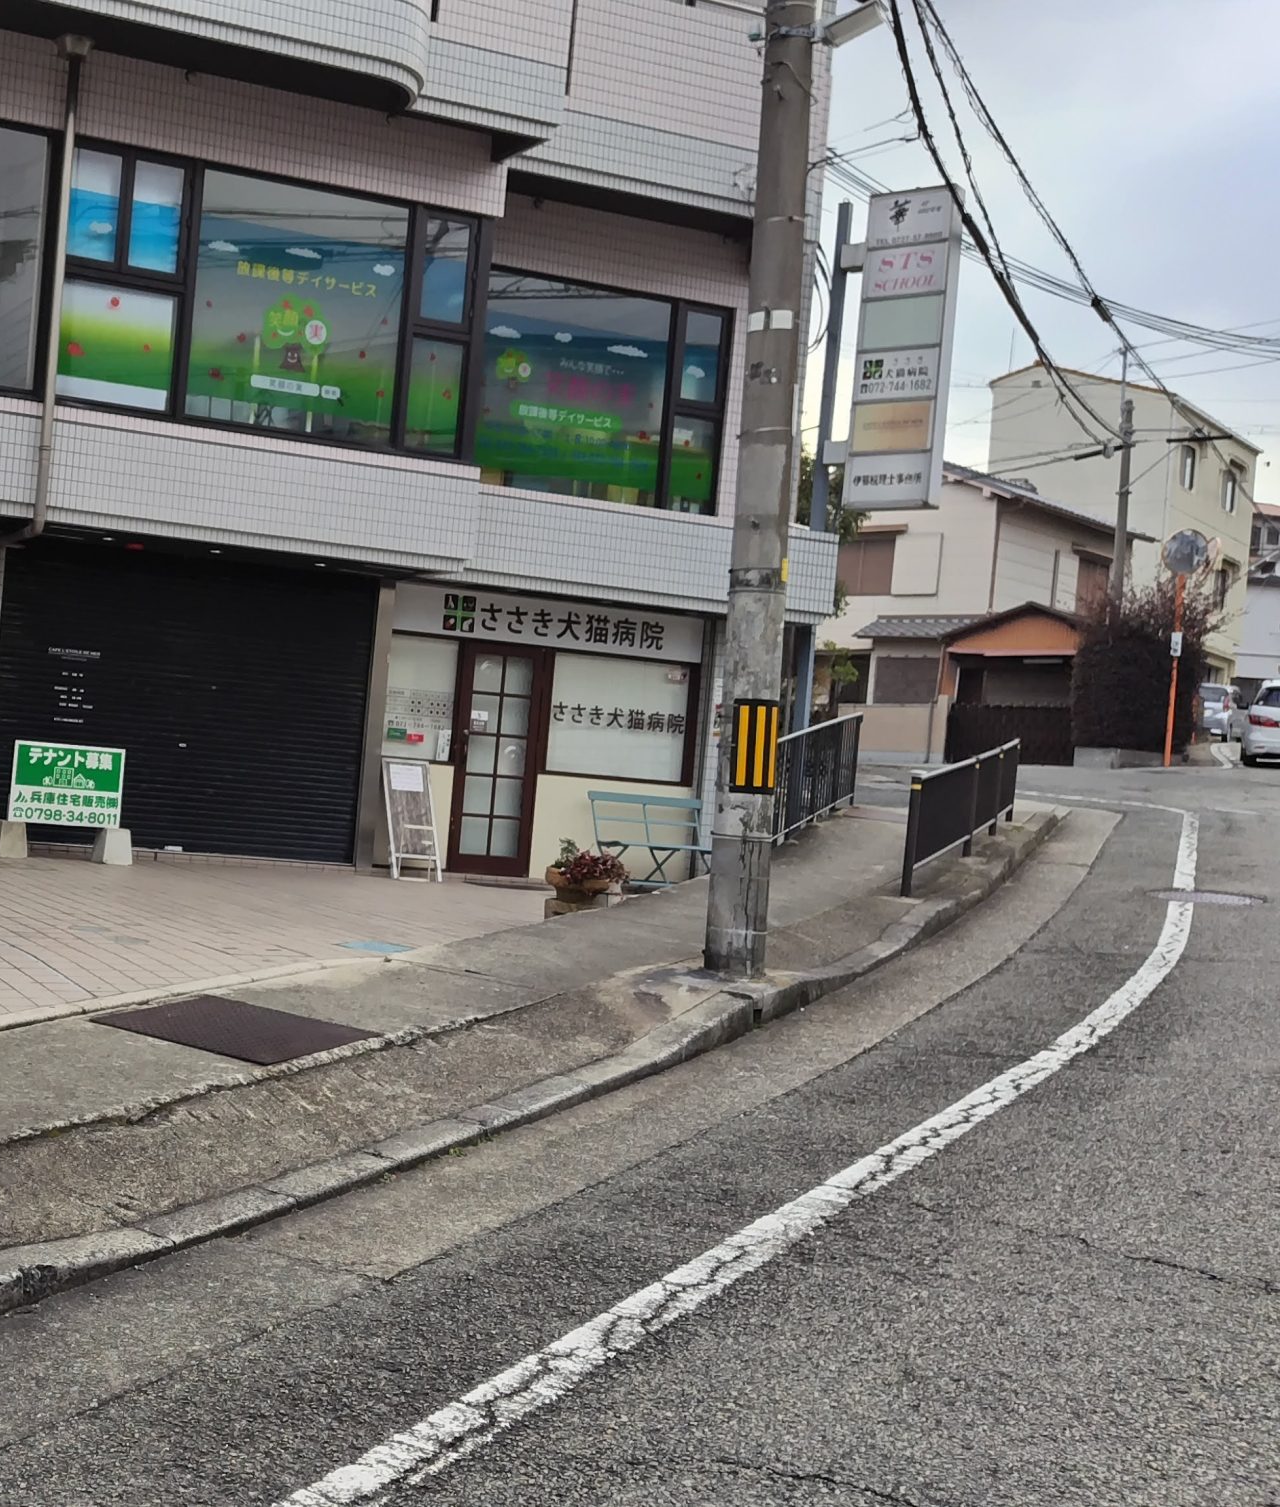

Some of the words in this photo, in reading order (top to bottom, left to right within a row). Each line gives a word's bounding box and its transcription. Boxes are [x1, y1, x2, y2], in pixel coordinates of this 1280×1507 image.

[878, 250, 935, 272] STS
[873, 274, 936, 292] SCHOOL
[480, 603, 666, 651] ささき犬猫病院
[553, 702, 686, 735] ささき犬猫病院
[29, 747, 113, 771] テナント募集
